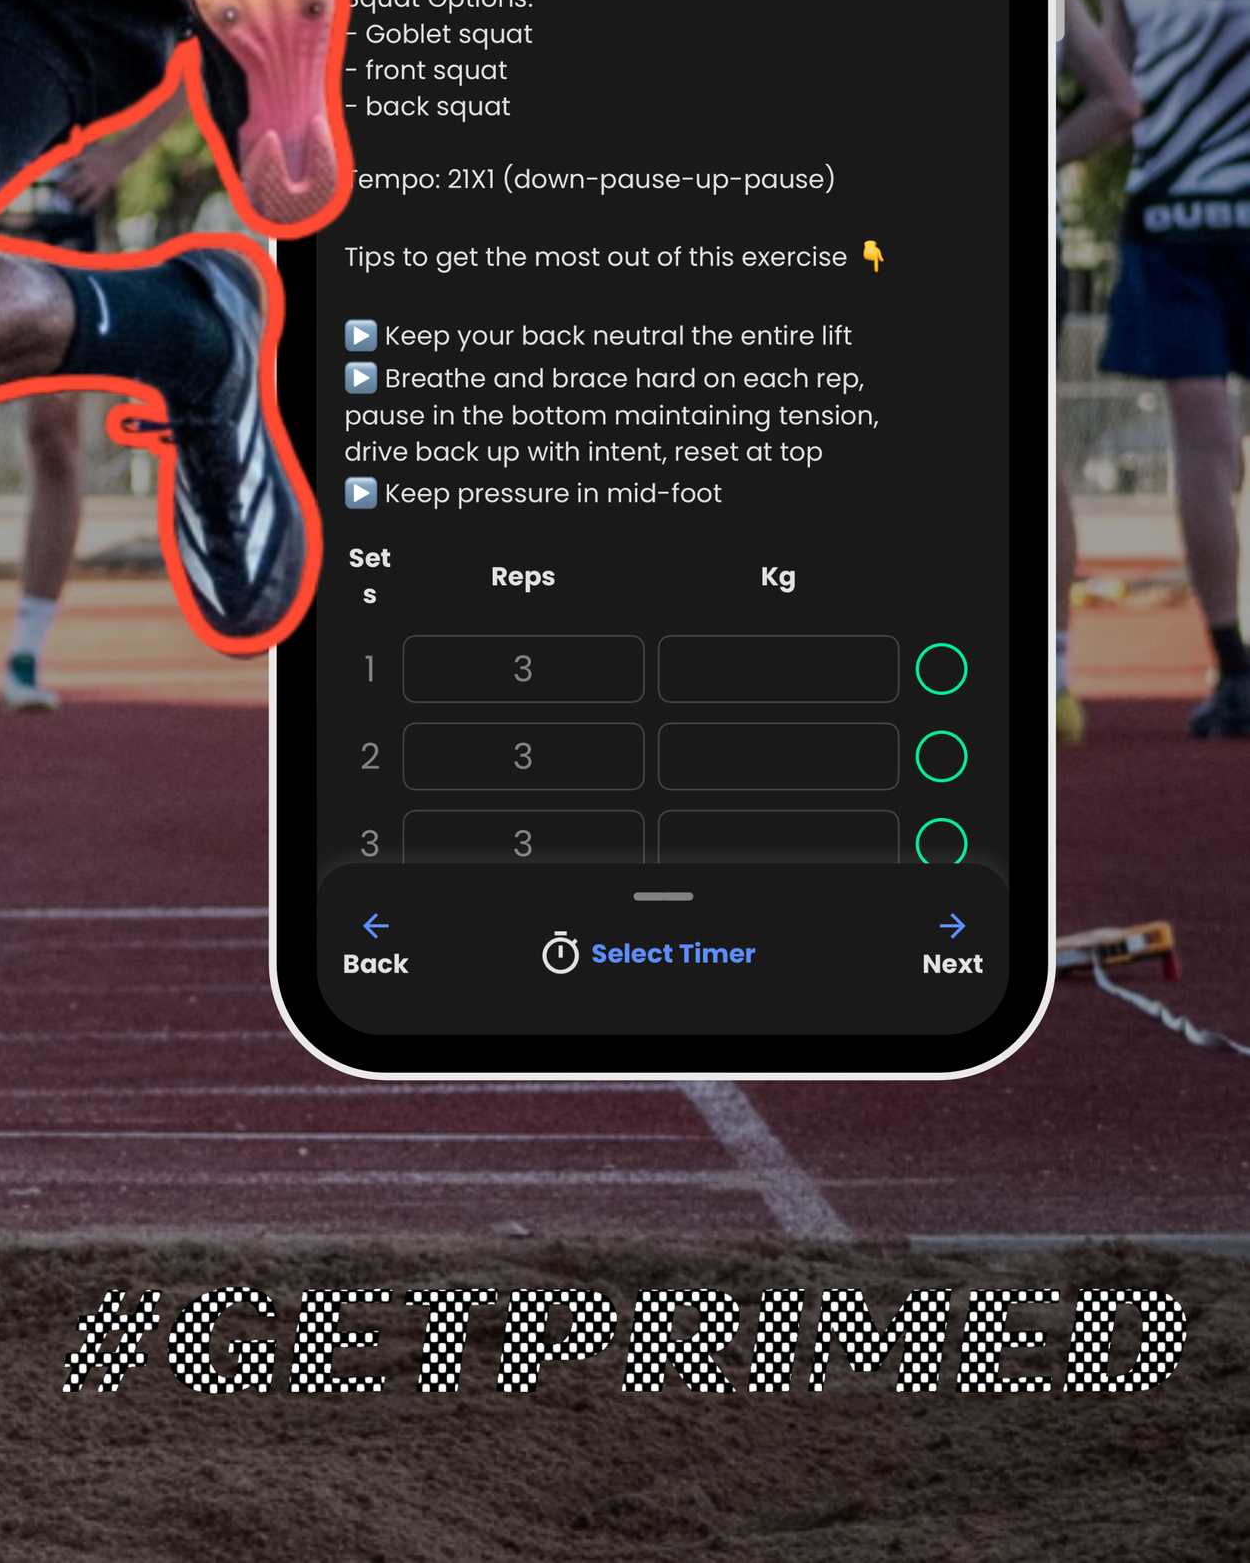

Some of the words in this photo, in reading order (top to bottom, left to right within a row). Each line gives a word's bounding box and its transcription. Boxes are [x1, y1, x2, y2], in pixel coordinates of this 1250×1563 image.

[365, 23, 452, 44] Goblet
[458, 24, 533, 51] squat
[365, 58, 426, 80] front
[433, 60, 508, 87] squat
[366, 95, 430, 117] back
[436, 96, 511, 123] squat
[448, 168, 494, 189] 21X1
[504, 163, 835, 196] (down-pause-up-pause)
[344, 245, 395, 274] Tips
[402, 247, 428, 267] to
[436, 247, 479, 274] get
[485, 246, 527, 267] the
[535, 247, 601, 267] most
[607, 247, 650, 267] out
[657, 245, 682, 267] of
[688, 245, 734, 267] this
[741, 245, 848, 267] exercise
[386, 325, 450, 352] Keep
[457, 329, 515, 352] your
[522, 324, 586, 346] back
[593, 324, 684, 346] neutral
[691, 324, 733, 346] the
[740, 324, 815, 346] entire
[822, 324, 853, 346] lift
[386, 367, 486, 389] Breathe
[493, 367, 544, 389] and
[552, 367, 628, 389] brace
[636, 367, 696, 389] hard
[703, 372, 736, 389] on
[743, 367, 809, 389] each
[817, 372, 864, 395] rep,
[345, 409, 425, 432] pause
[433, 404, 455, 426] in
[462, 404, 504, 426] the
[512, 404, 607, 426] bottom
[615, 404, 770, 433] maintaining
[778, 404, 879, 429] tension,
[344, 440, 408, 462] drive
[416, 440, 479, 462] back
[487, 445, 520, 469] up
[527, 440, 580, 462] with
[588, 440, 667, 465] intent,
[675, 442, 739, 462] reset
[746, 442, 773, 462] at
[779, 442, 823, 469] top
[386, 483, 450, 510] Keep
[458, 487, 570, 510] pressure
[577, 481, 599, 503] in
[607, 481, 722, 504] mid-foot
[349, 547, 391, 568] Set
[492, 566, 556, 593] Reps
[761, 566, 796, 594] Kg
[363, 587, 377, 604] s
[365, 655, 373, 683] 1
[513, 654, 533, 683] 3
[361, 742, 380, 770] 2
[513, 742, 533, 770] 3
[360, 829, 379, 858] 3
[513, 829, 533, 858] 3
[343, 953, 409, 974] Back
[591, 942, 674, 964] Select
[678, 941, 756, 964] Timer
[923, 954, 984, 974] Next
